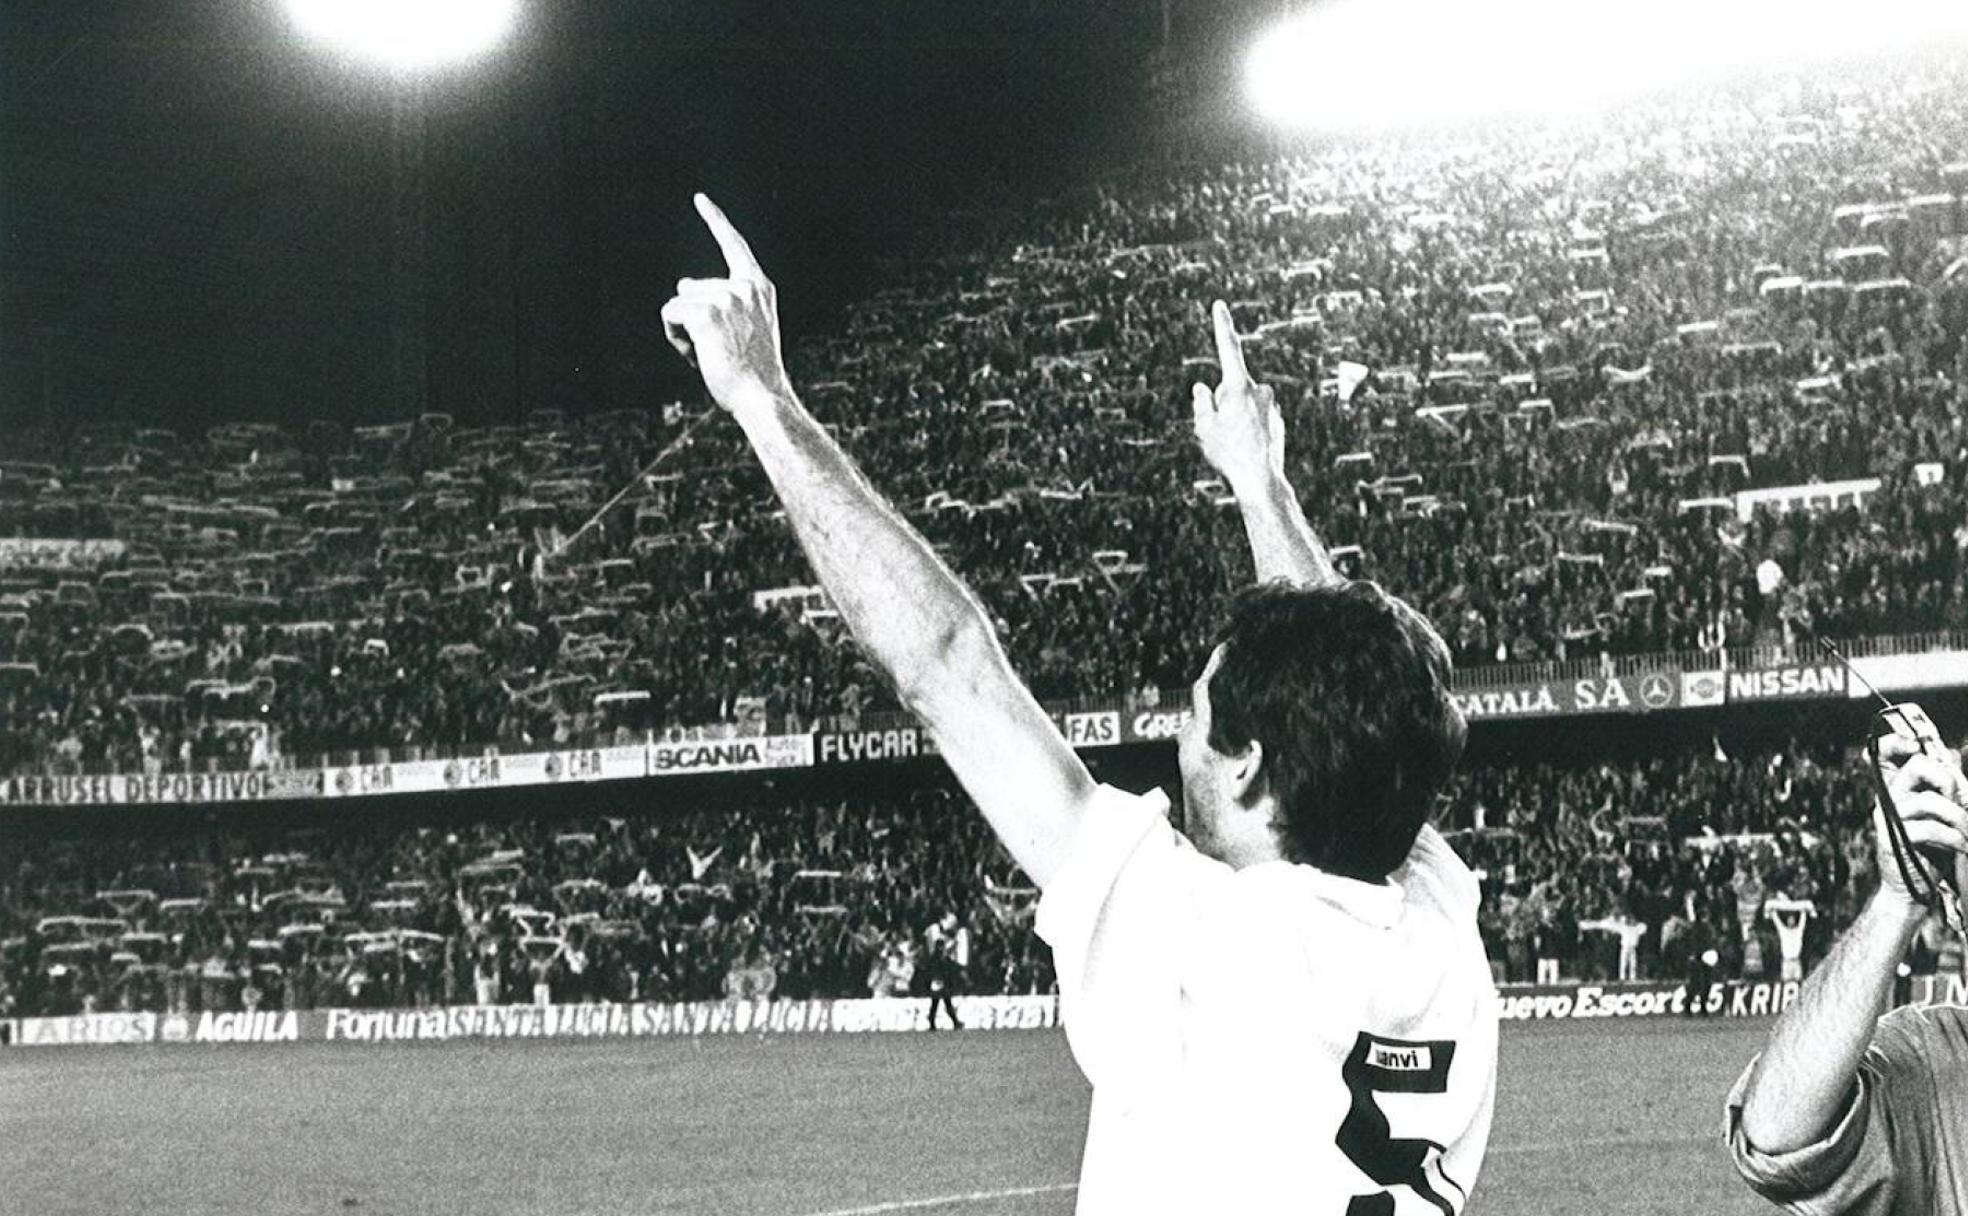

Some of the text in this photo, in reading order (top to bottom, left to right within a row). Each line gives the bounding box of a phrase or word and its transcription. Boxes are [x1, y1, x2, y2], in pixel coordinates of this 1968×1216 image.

[1730, 667, 1844, 698] NISSAN
[1070, 716, 1113, 742] FAS
[656, 744, 760, 769] SCANIA
[821, 729, 917, 763] FLYCAR
[126, 772, 257, 801] DEPORTIVO
[1498, 995, 1573, 1020] uevo
[1572, 983, 1687, 1018] Escort
[34, 1015, 147, 1042] ARIOS
[327, 1007, 449, 1040] Fortuna
[1335, 1031, 1467, 1216] 5
